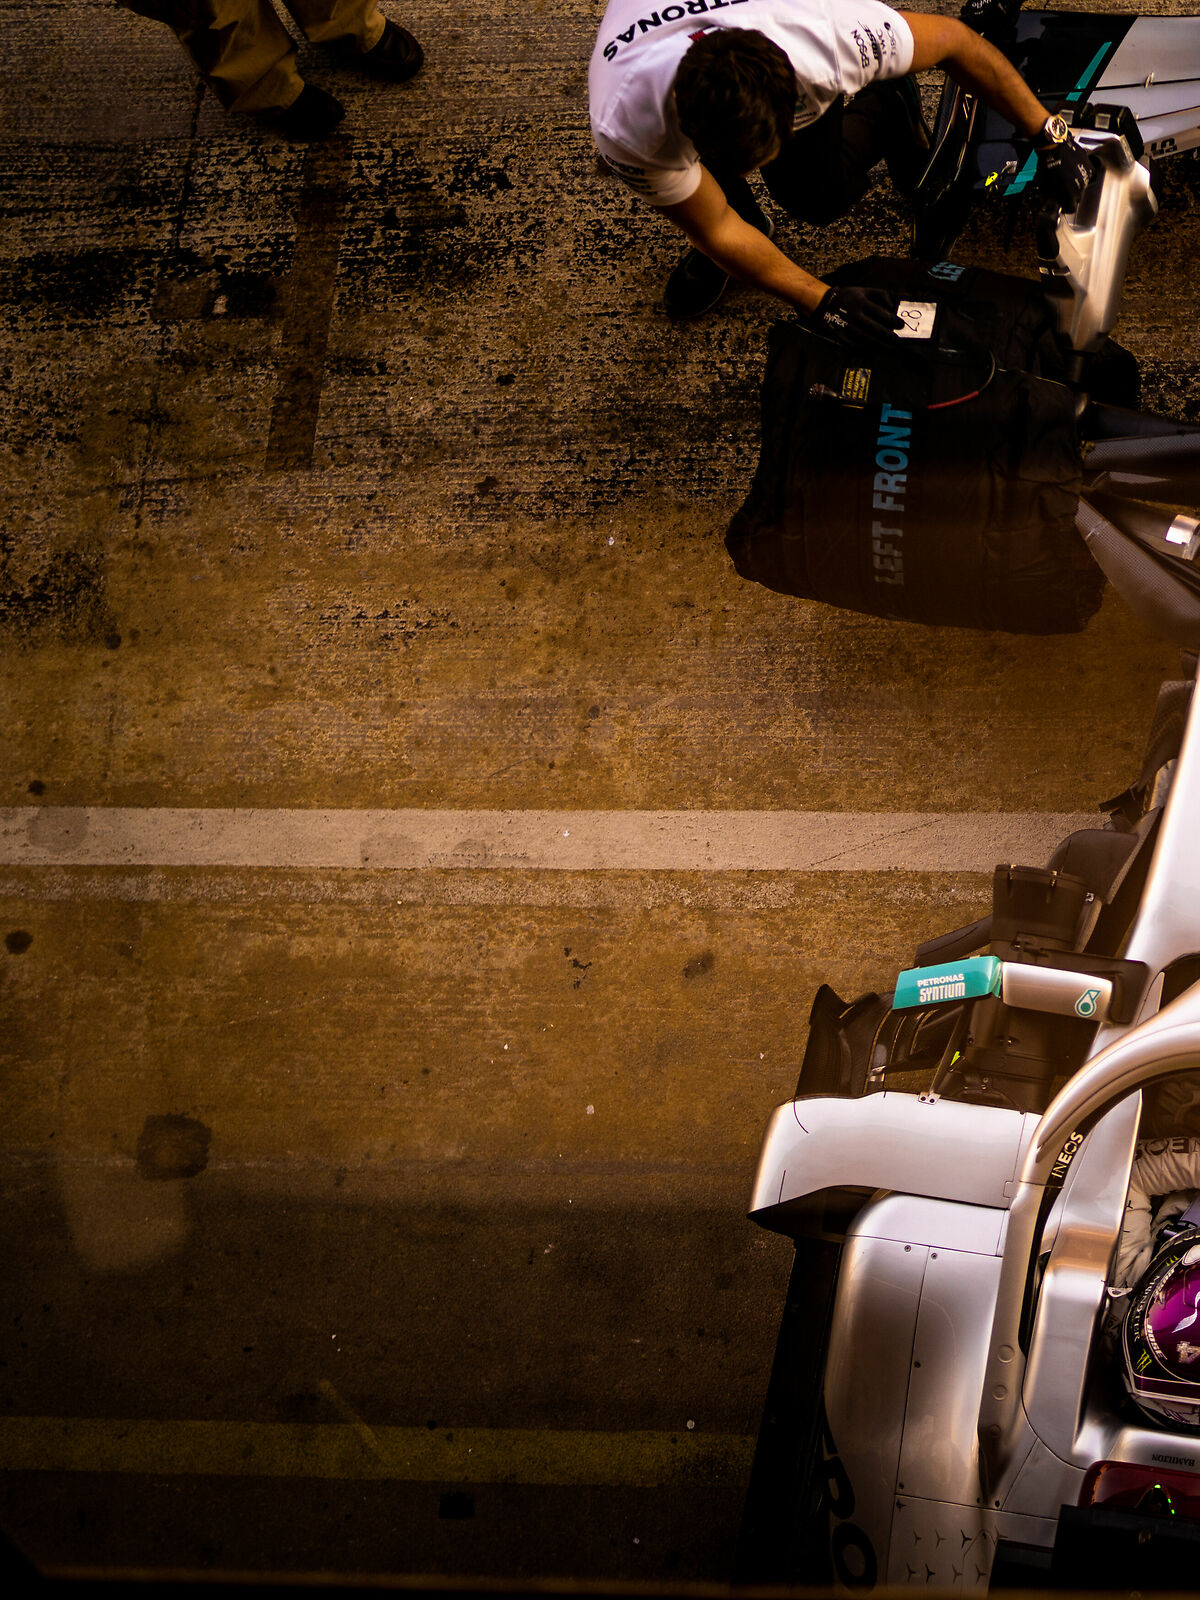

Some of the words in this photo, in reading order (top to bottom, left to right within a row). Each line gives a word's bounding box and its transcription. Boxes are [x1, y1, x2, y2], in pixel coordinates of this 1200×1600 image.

[872, 402, 913, 512] FRONT
[871, 521, 904, 586] LEFT
[917, 973, 965, 988] PETRONAS
[919, 981, 966, 1003] SYNTIUM
[1051, 1131, 1084, 1179] INEOS
[1151, 1453, 1196, 1468] HAMILTON
